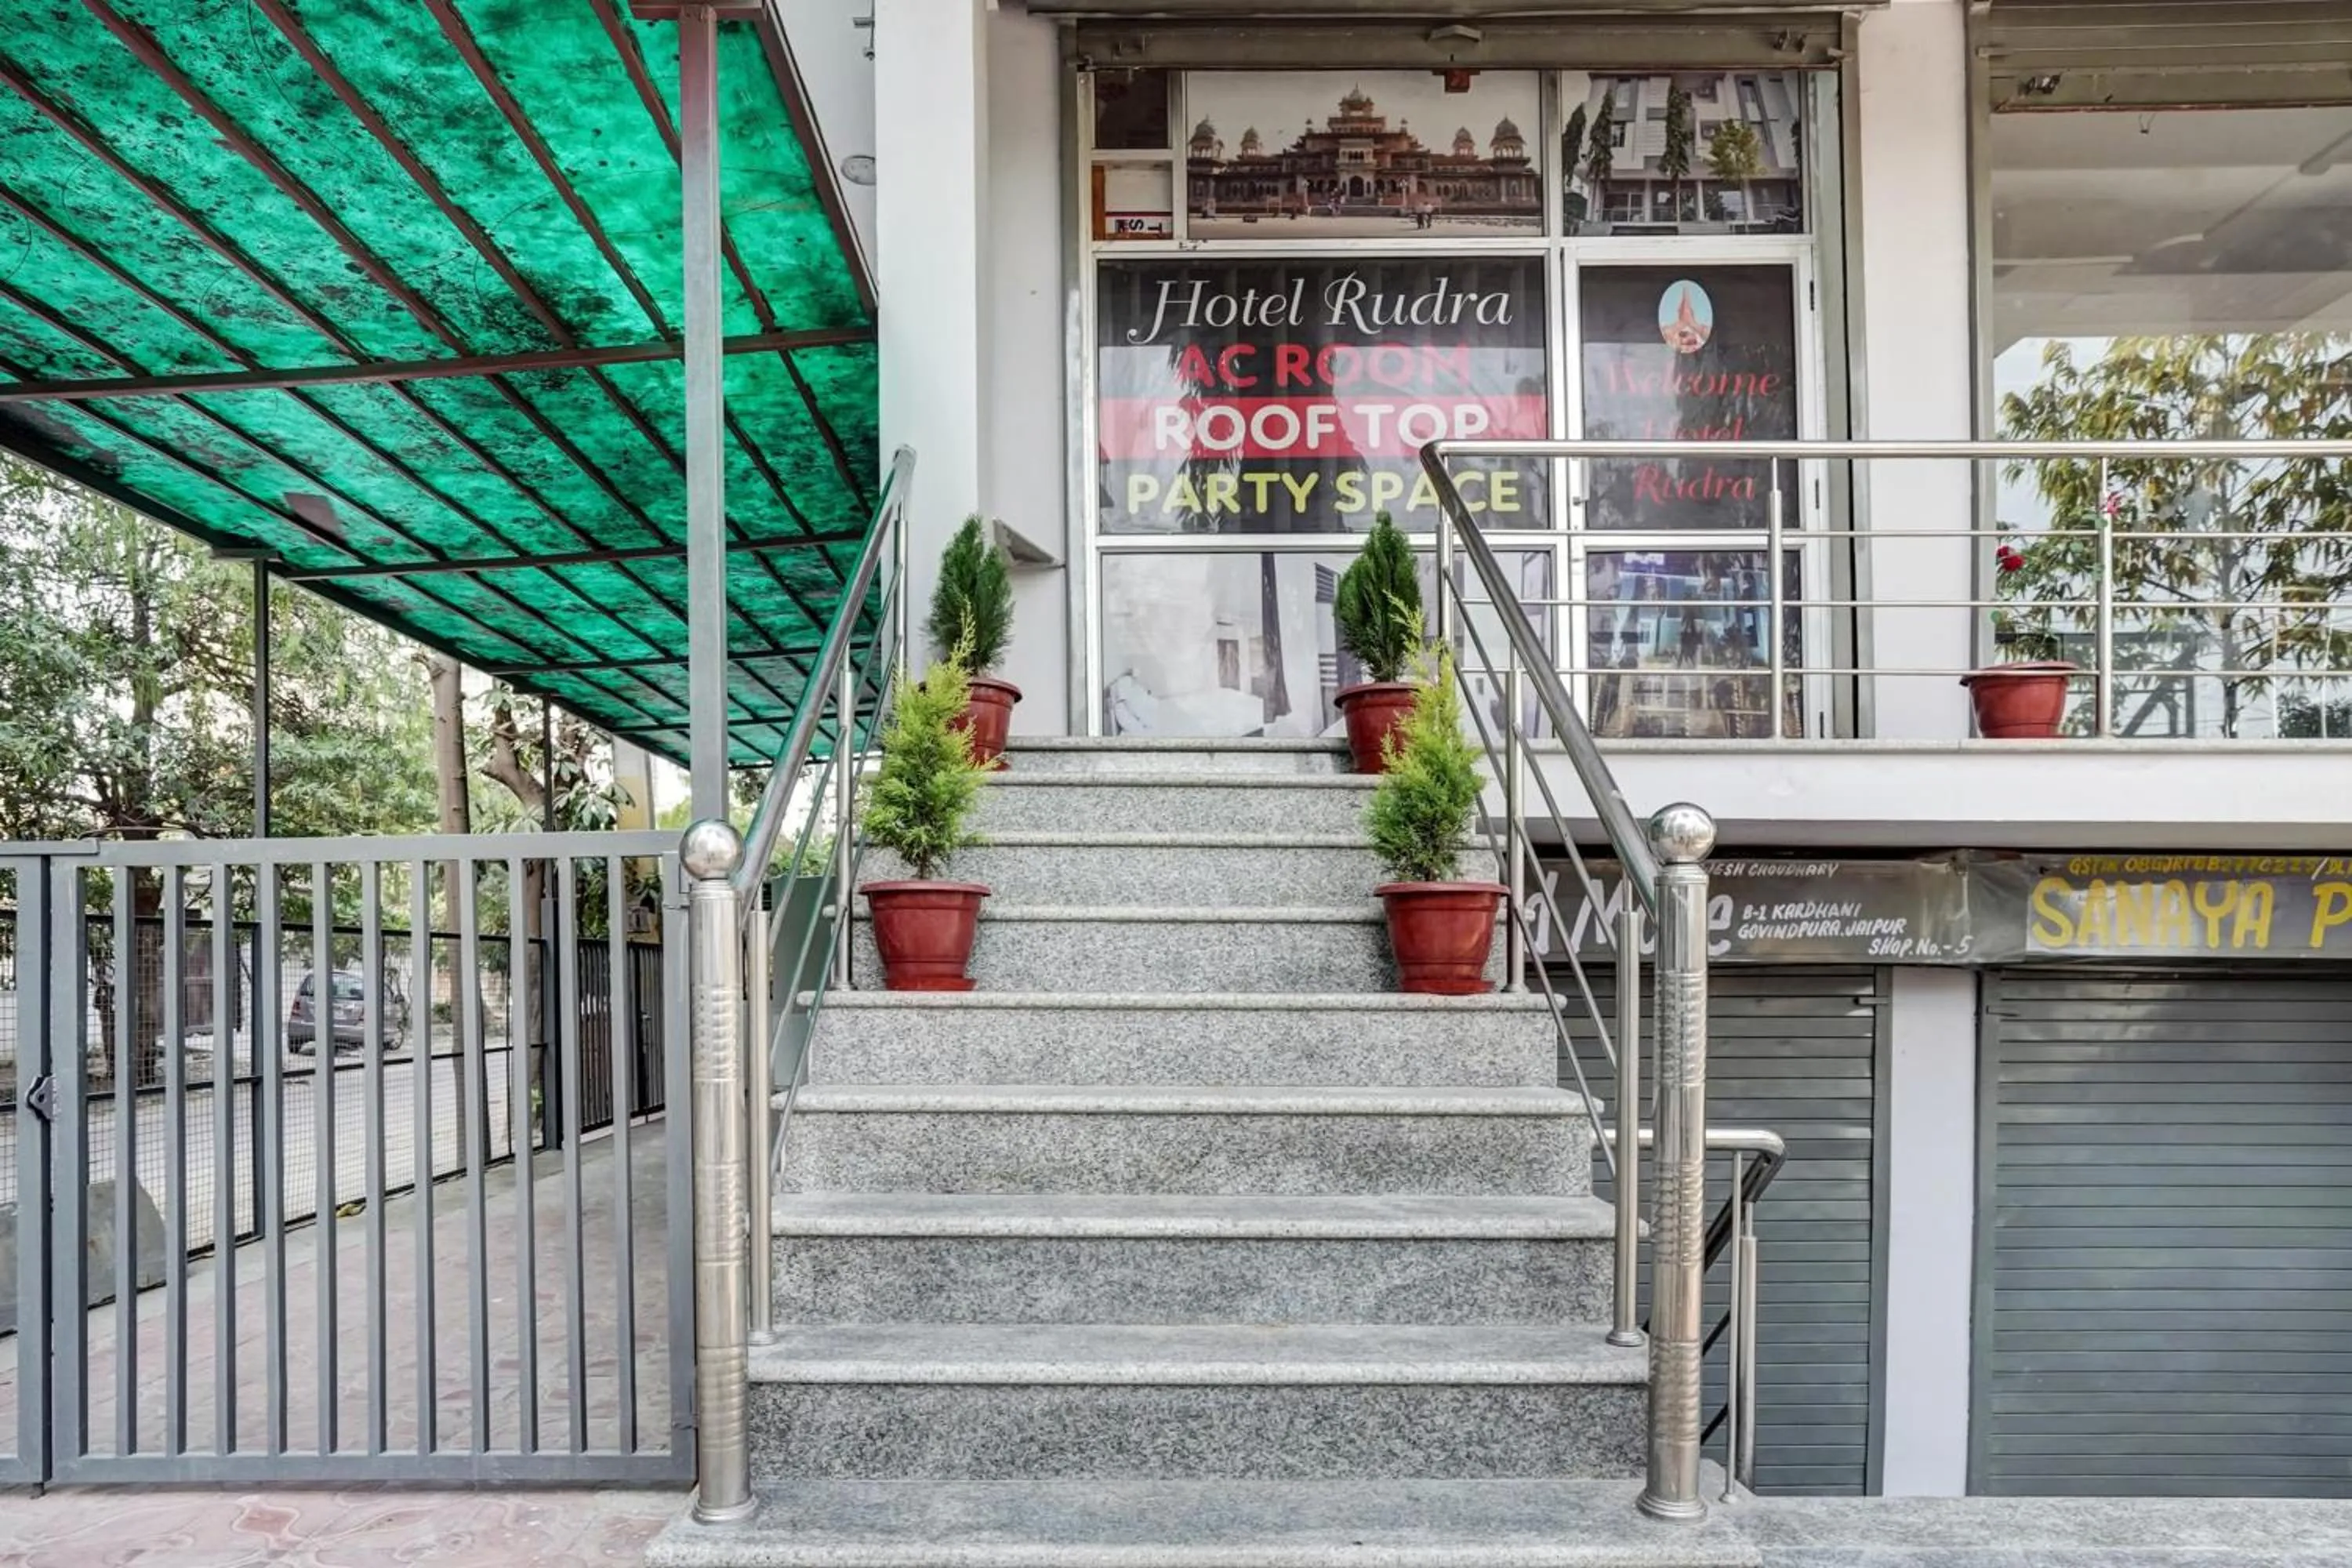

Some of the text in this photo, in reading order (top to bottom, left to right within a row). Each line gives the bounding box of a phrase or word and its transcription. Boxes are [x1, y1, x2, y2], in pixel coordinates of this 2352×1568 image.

[1127, 270, 1514, 344] Hotel Rudra
[1178, 343, 1471, 388] AC ROOM
[1154, 405, 1490, 451] ROOF TOP
[1127, 472, 1319, 514] PARTY
[1632, 463, 1756, 507] Rudra
[1748, 862, 1839, 878] CHOUDHARY
[1771, 902, 1862, 920] KARDHANI
[2031, 876, 2274, 950] SANAYA
